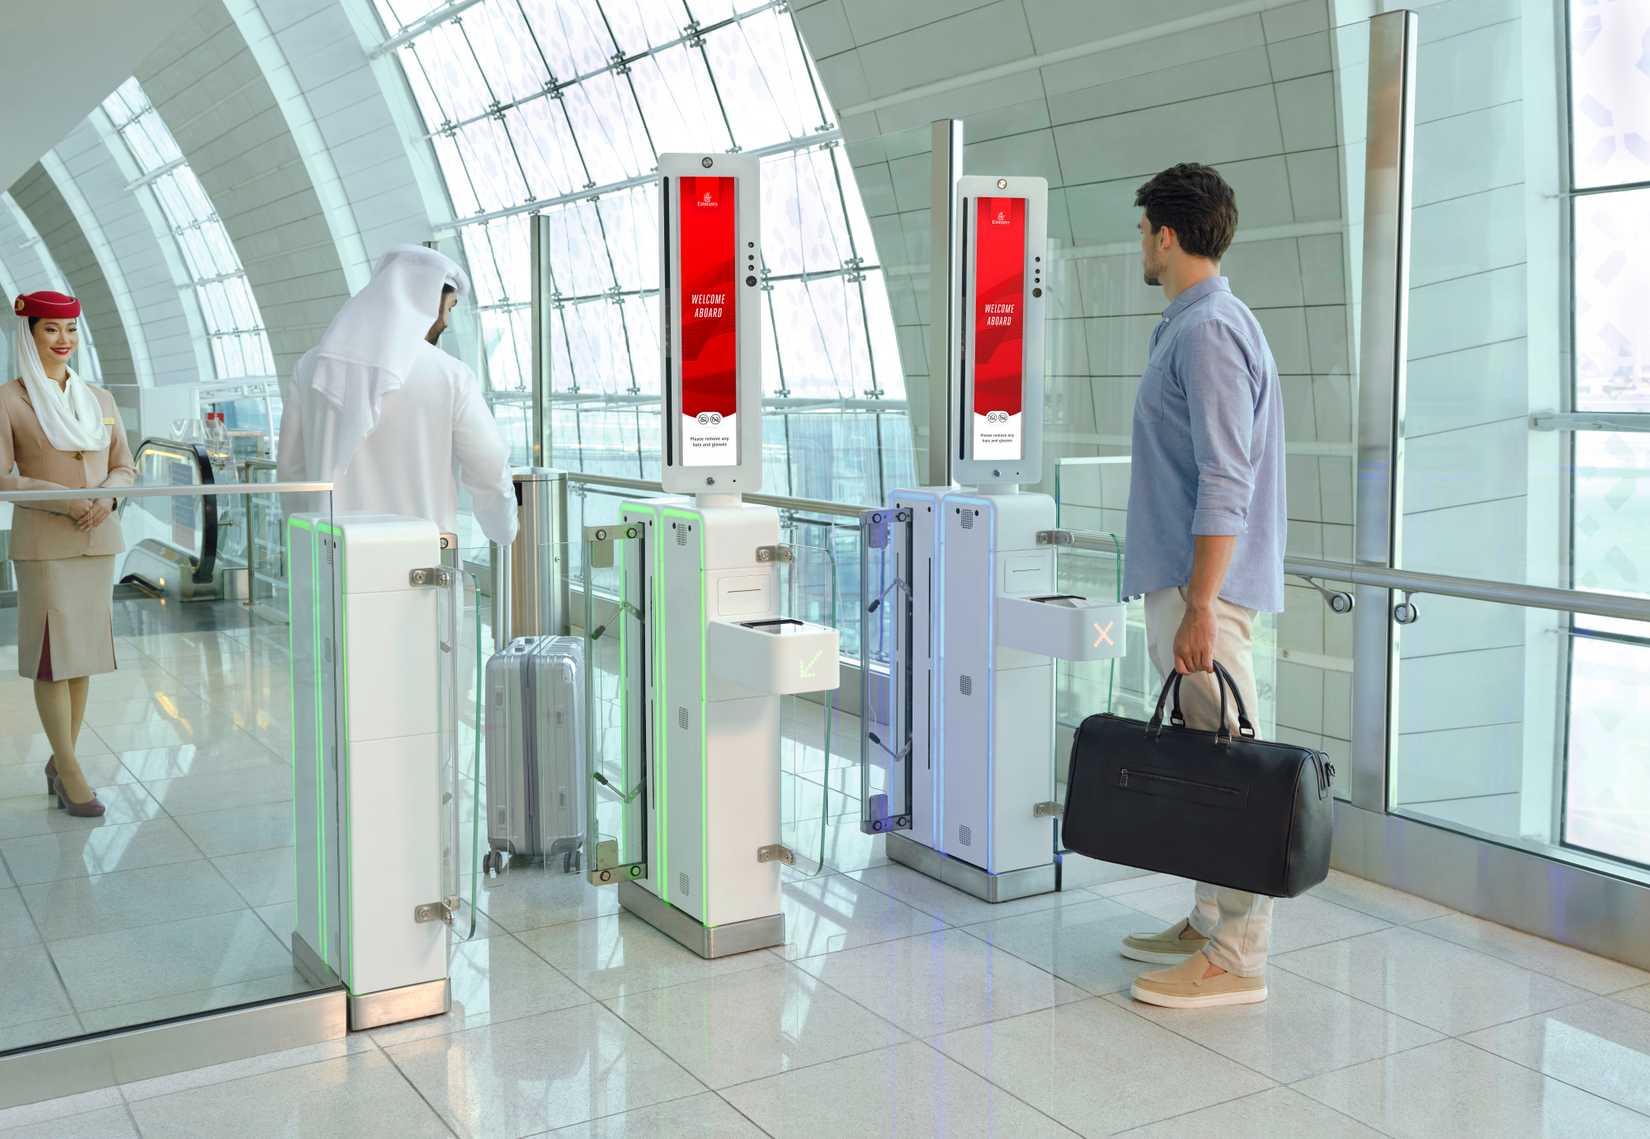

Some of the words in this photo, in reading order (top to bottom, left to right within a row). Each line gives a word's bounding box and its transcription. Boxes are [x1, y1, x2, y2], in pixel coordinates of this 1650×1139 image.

[691, 293, 726, 305] WELCOME
[694, 307, 723, 318] ABOARD
[985, 303, 1015, 314] WELCOME
[987, 316, 1012, 326] ABOARD
